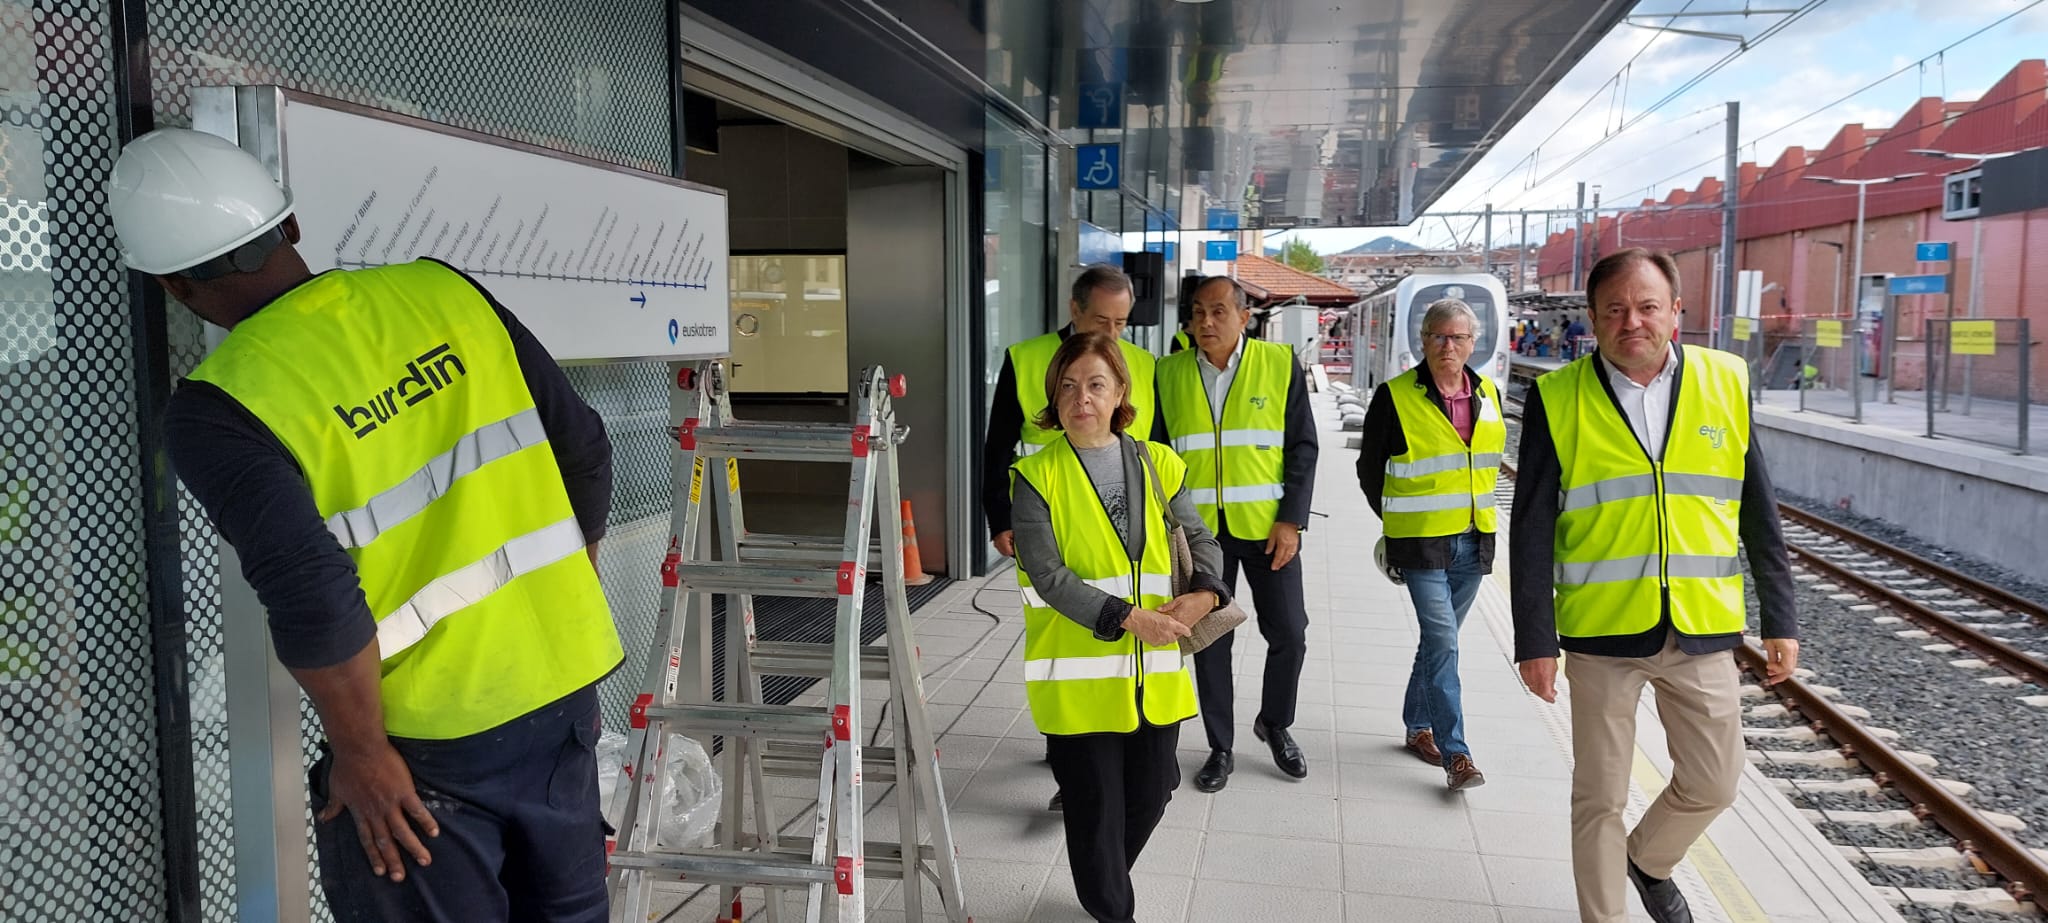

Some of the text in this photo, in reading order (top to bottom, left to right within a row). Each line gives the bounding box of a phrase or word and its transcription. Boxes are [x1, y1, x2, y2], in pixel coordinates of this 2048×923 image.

[335, 222, 357, 255] Matiko
[358, 190, 377, 218] Bilbao
[682, 322, 717, 337] euskotren
[333, 342, 467, 440] burdin
